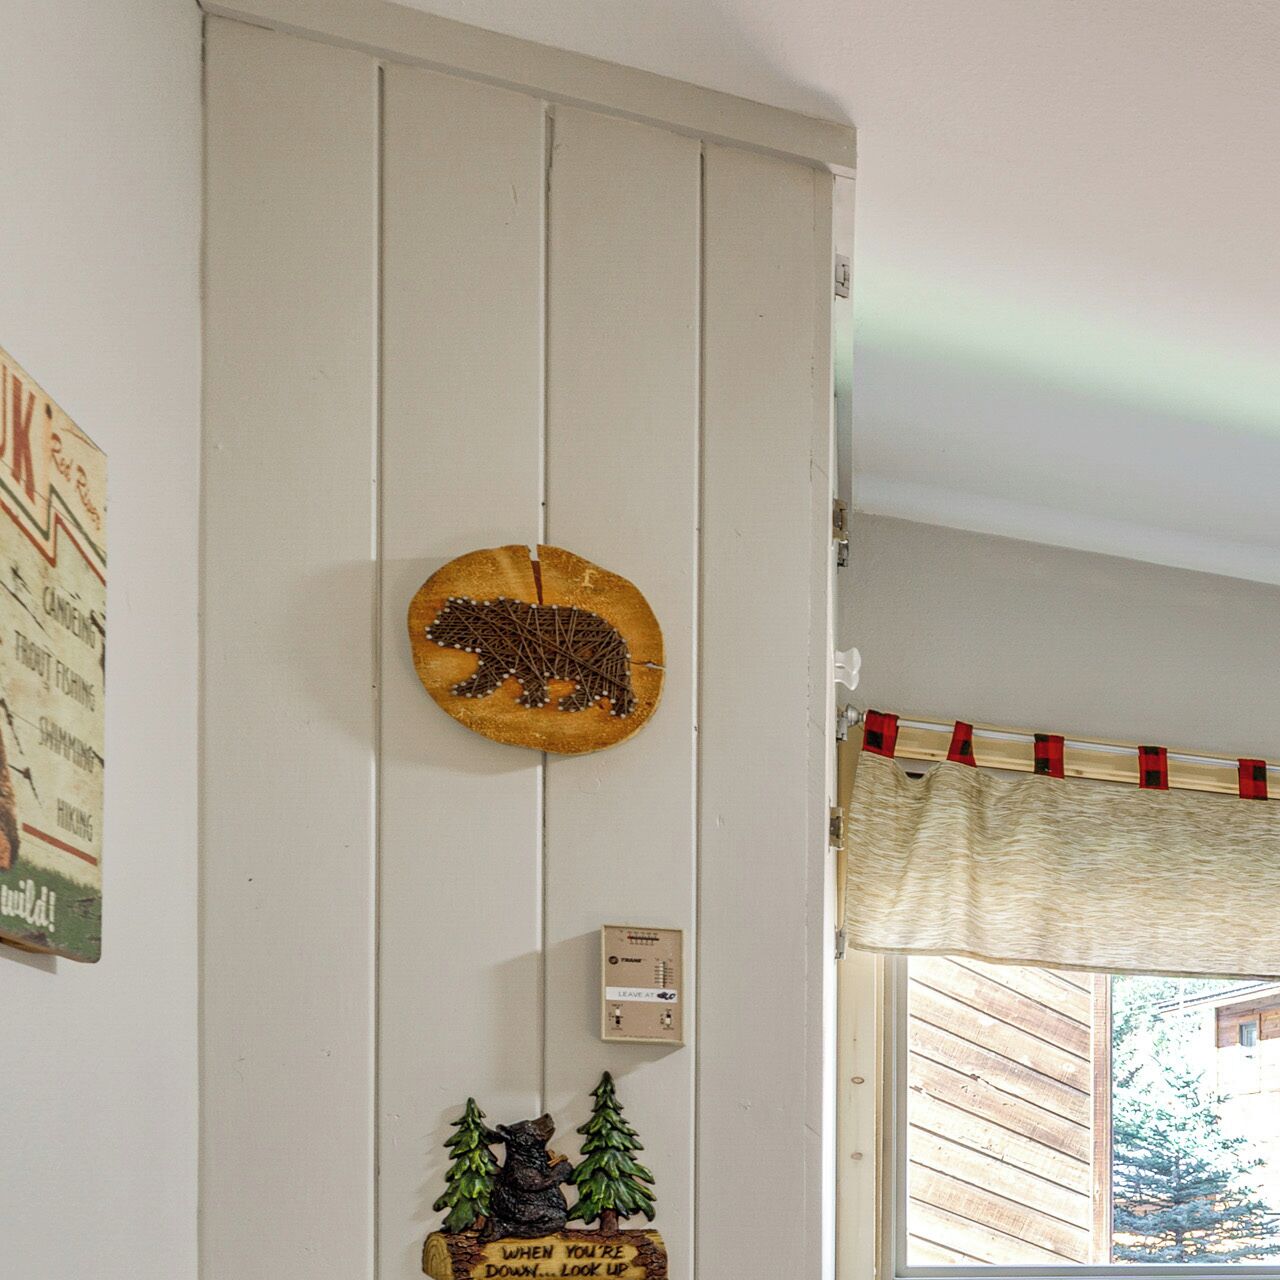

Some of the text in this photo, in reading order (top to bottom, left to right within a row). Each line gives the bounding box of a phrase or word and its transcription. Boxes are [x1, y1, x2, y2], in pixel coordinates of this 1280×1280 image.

[42, 586, 96, 649] CANOEING
[56, 797, 94, 843] HIKING
[0, 879, 56, 934] wild!
[501, 1244, 624, 1261] WHEN YOU'RE
[560, 1261, 601, 1278] LOOK
[606, 1263, 629, 1278] UP
